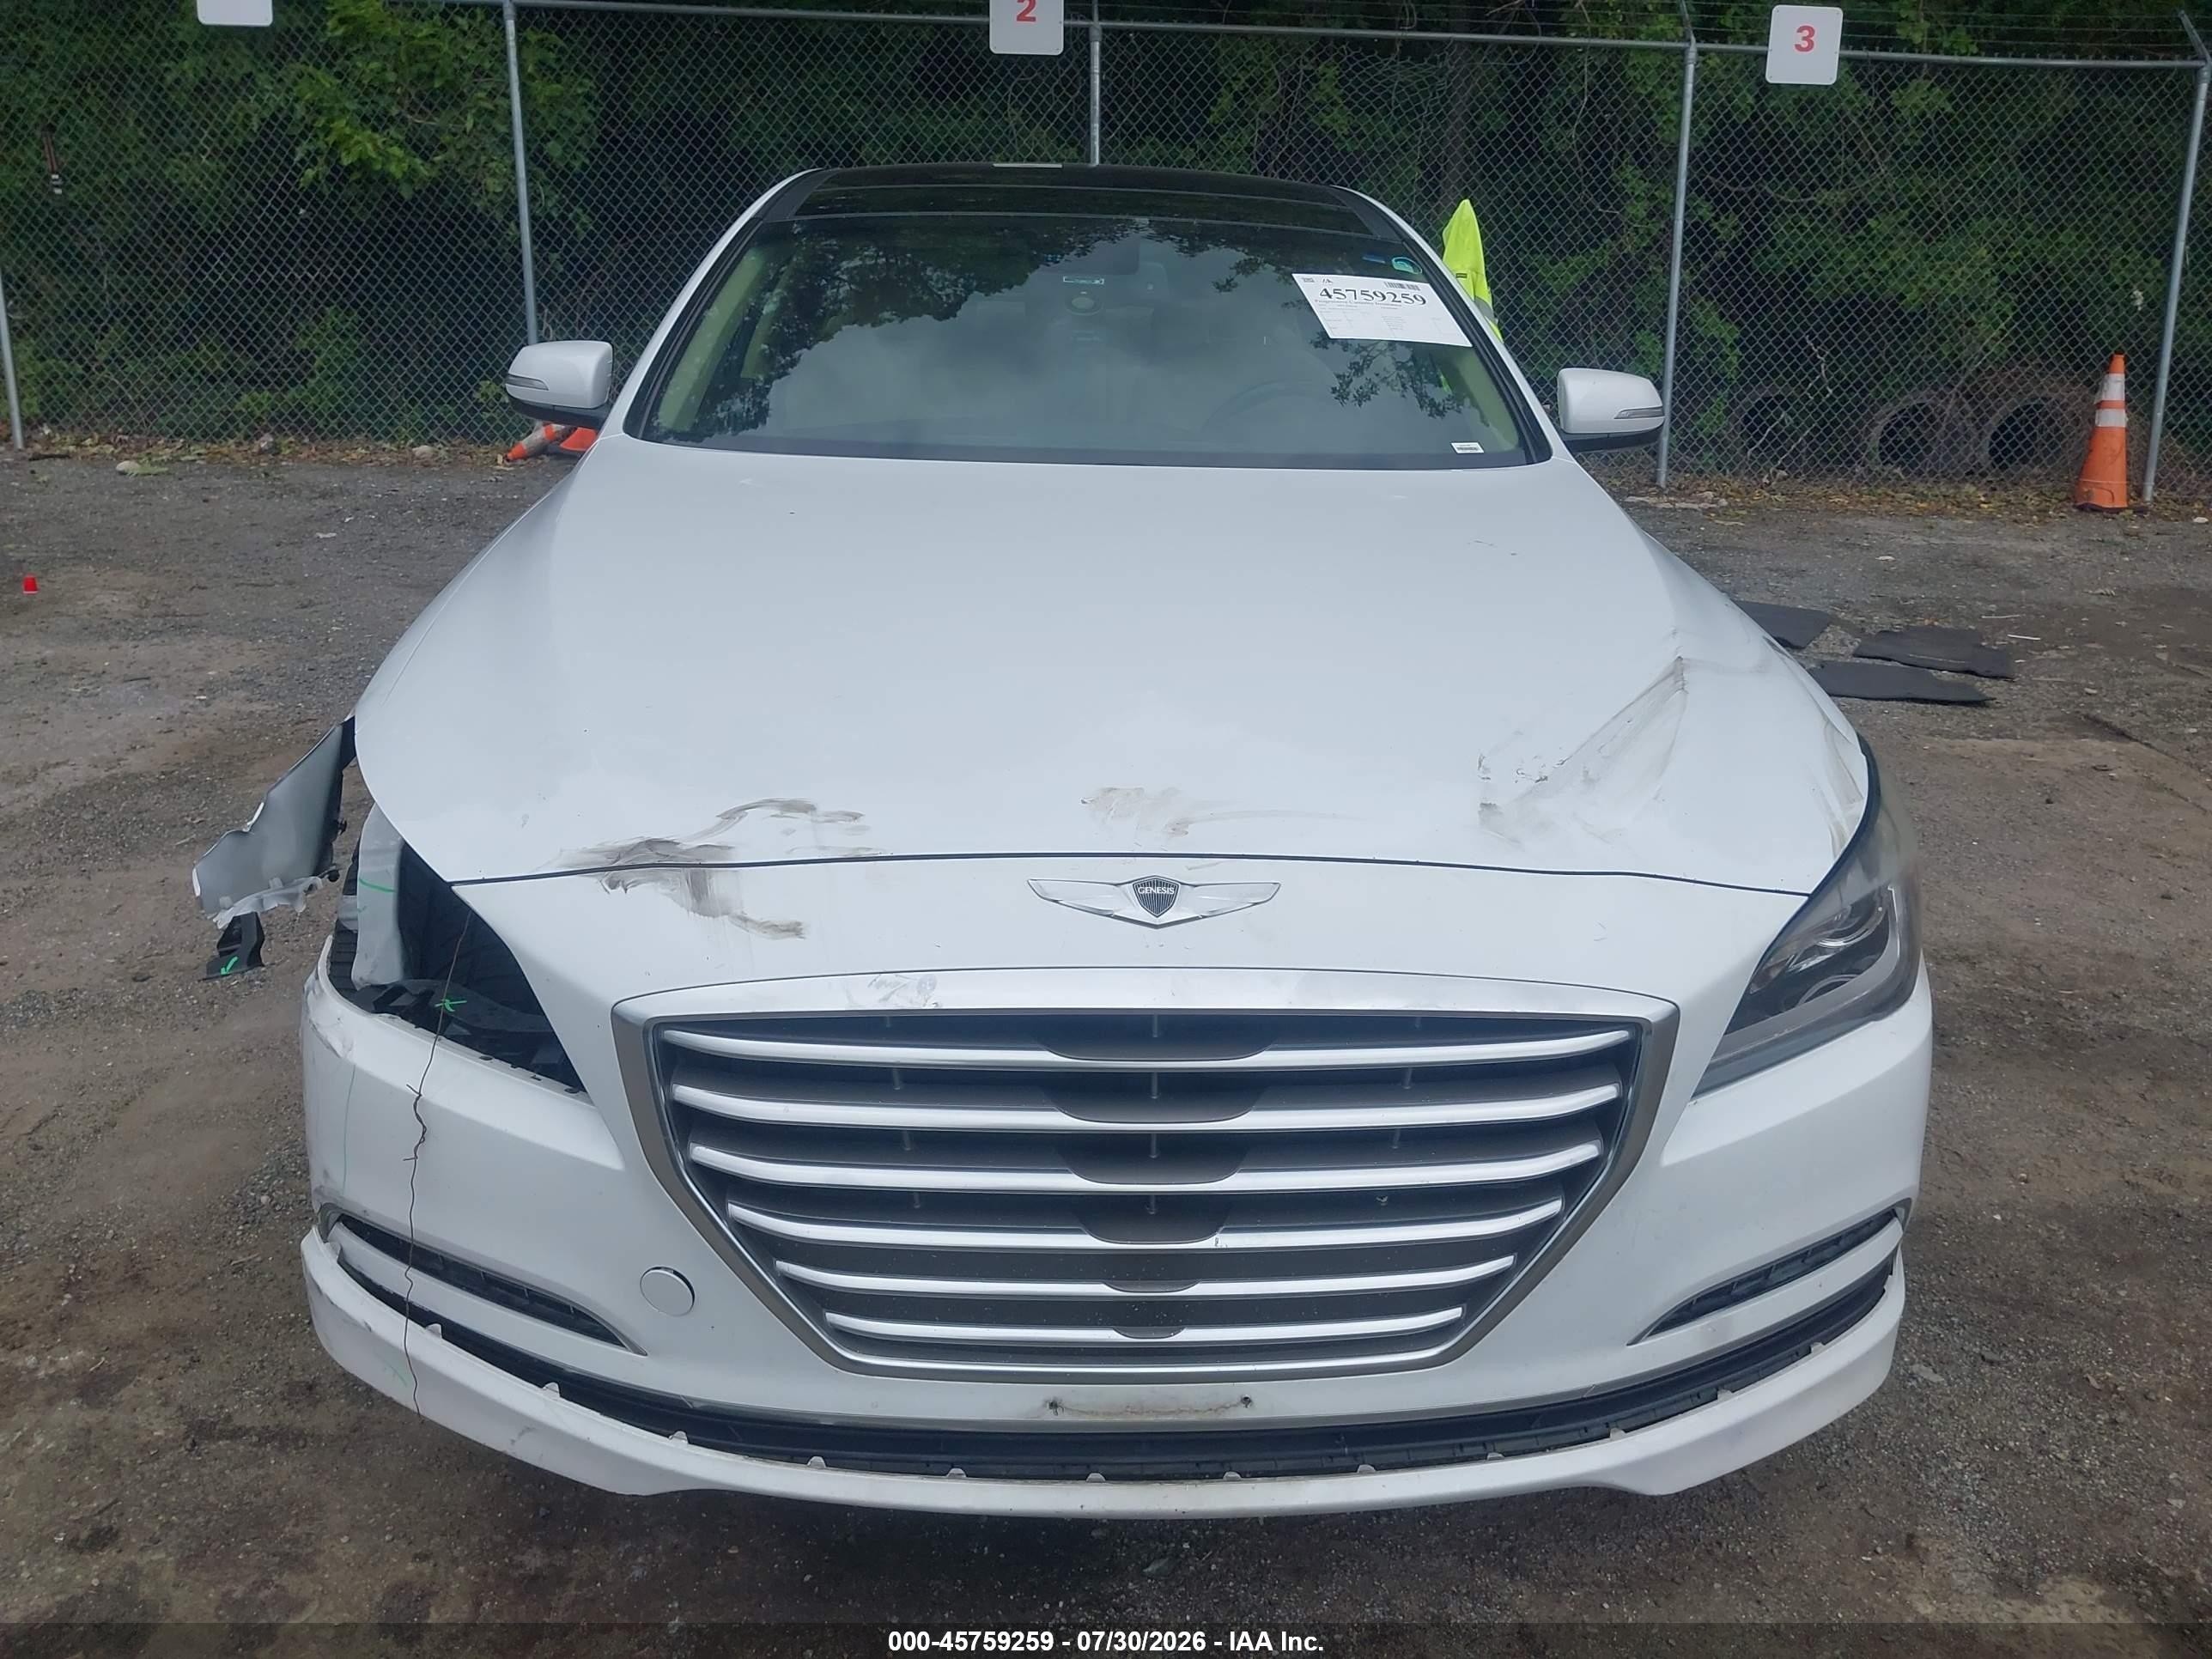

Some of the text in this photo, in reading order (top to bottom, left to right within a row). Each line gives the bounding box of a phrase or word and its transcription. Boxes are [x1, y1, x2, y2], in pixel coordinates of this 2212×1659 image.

[1016, 0, 1036, 22] 2
[1795, 25, 1815, 52] 3
[1319, 288, 1427, 306] 45759259
[1138, 886, 1175, 895] GENESIS
